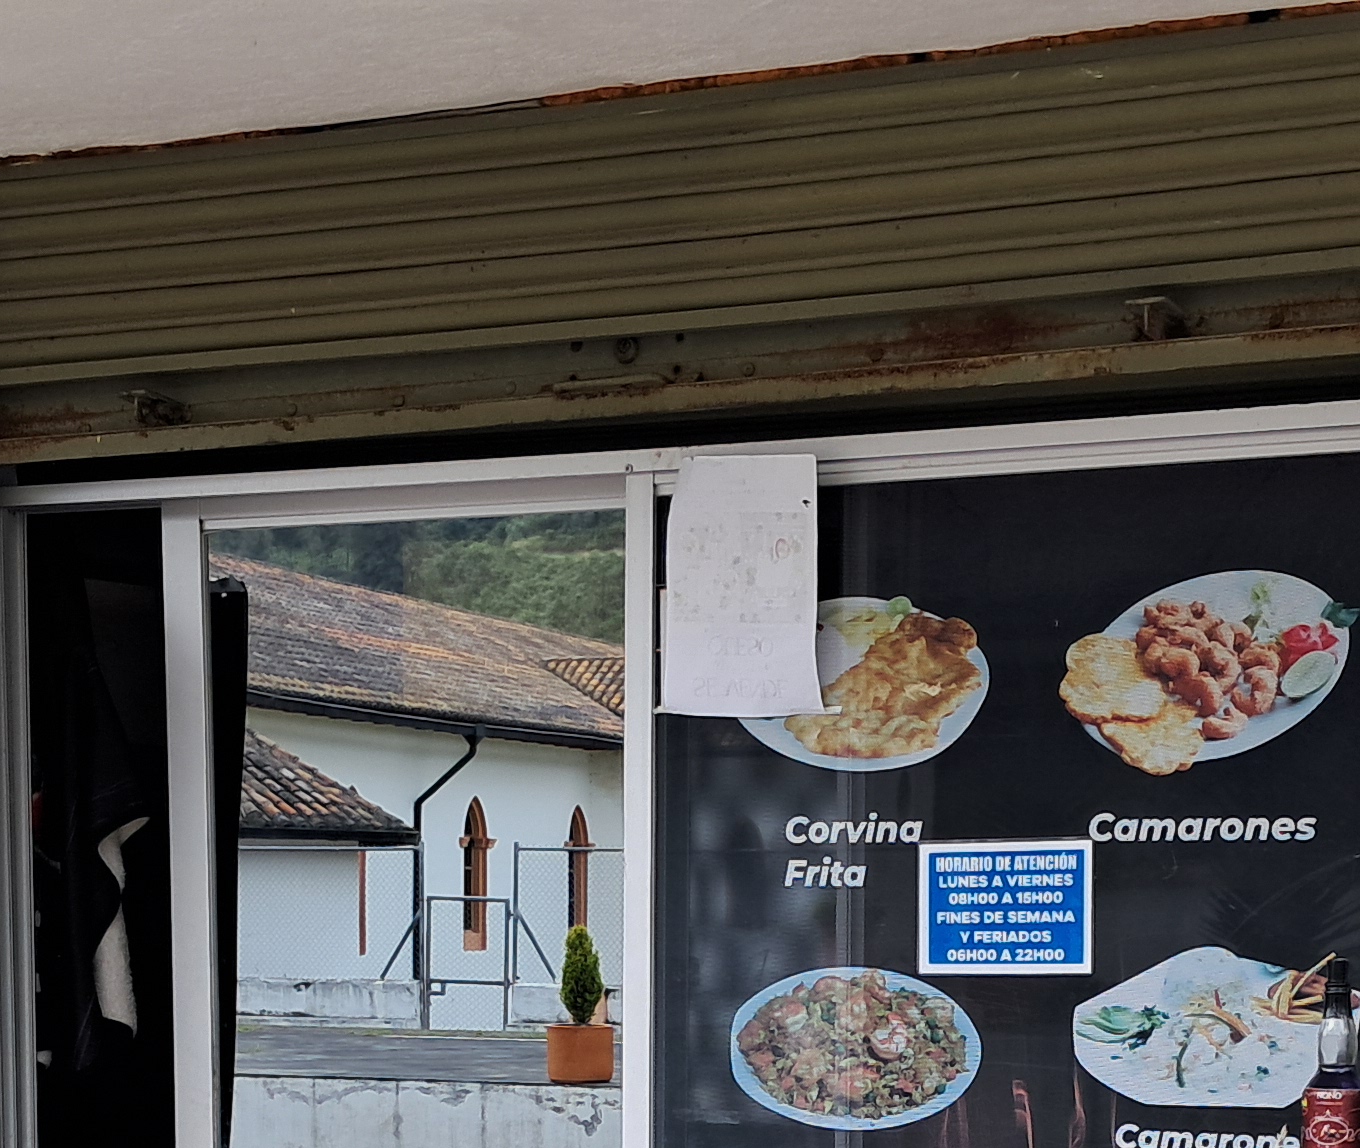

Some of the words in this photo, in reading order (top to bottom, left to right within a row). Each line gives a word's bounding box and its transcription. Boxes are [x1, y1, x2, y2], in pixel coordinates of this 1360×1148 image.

[785, 812, 923, 845] Corvina
[1088, 811, 1318, 843] Camarones
[935, 856, 993, 872] HORARIO
[996, 856, 1011, 872] DE
[1014, 852, 1077, 872] ATENCIÓN
[784, 856, 866, 888] Frita
[939, 875, 988, 888] LUNES
[991, 876, 1003, 887] A
[1006, 874, 1073, 887] VIERNES
[948, 892, 998, 905] 08H00
[1001, 892, 1013, 904] A
[1016, 891, 1063, 904] 15H00
[936, 911, 980, 924] FINES
[984, 911, 1004, 924] DE
[1007, 910, 1075, 924] SEMANA
[959, 931, 970, 943] Y
[974, 931, 1051, 943] FERIADOS
[947, 949, 997, 961] 06H00
[1000, 949, 1012, 961] A
[1015, 949, 1065, 961] 22H00
